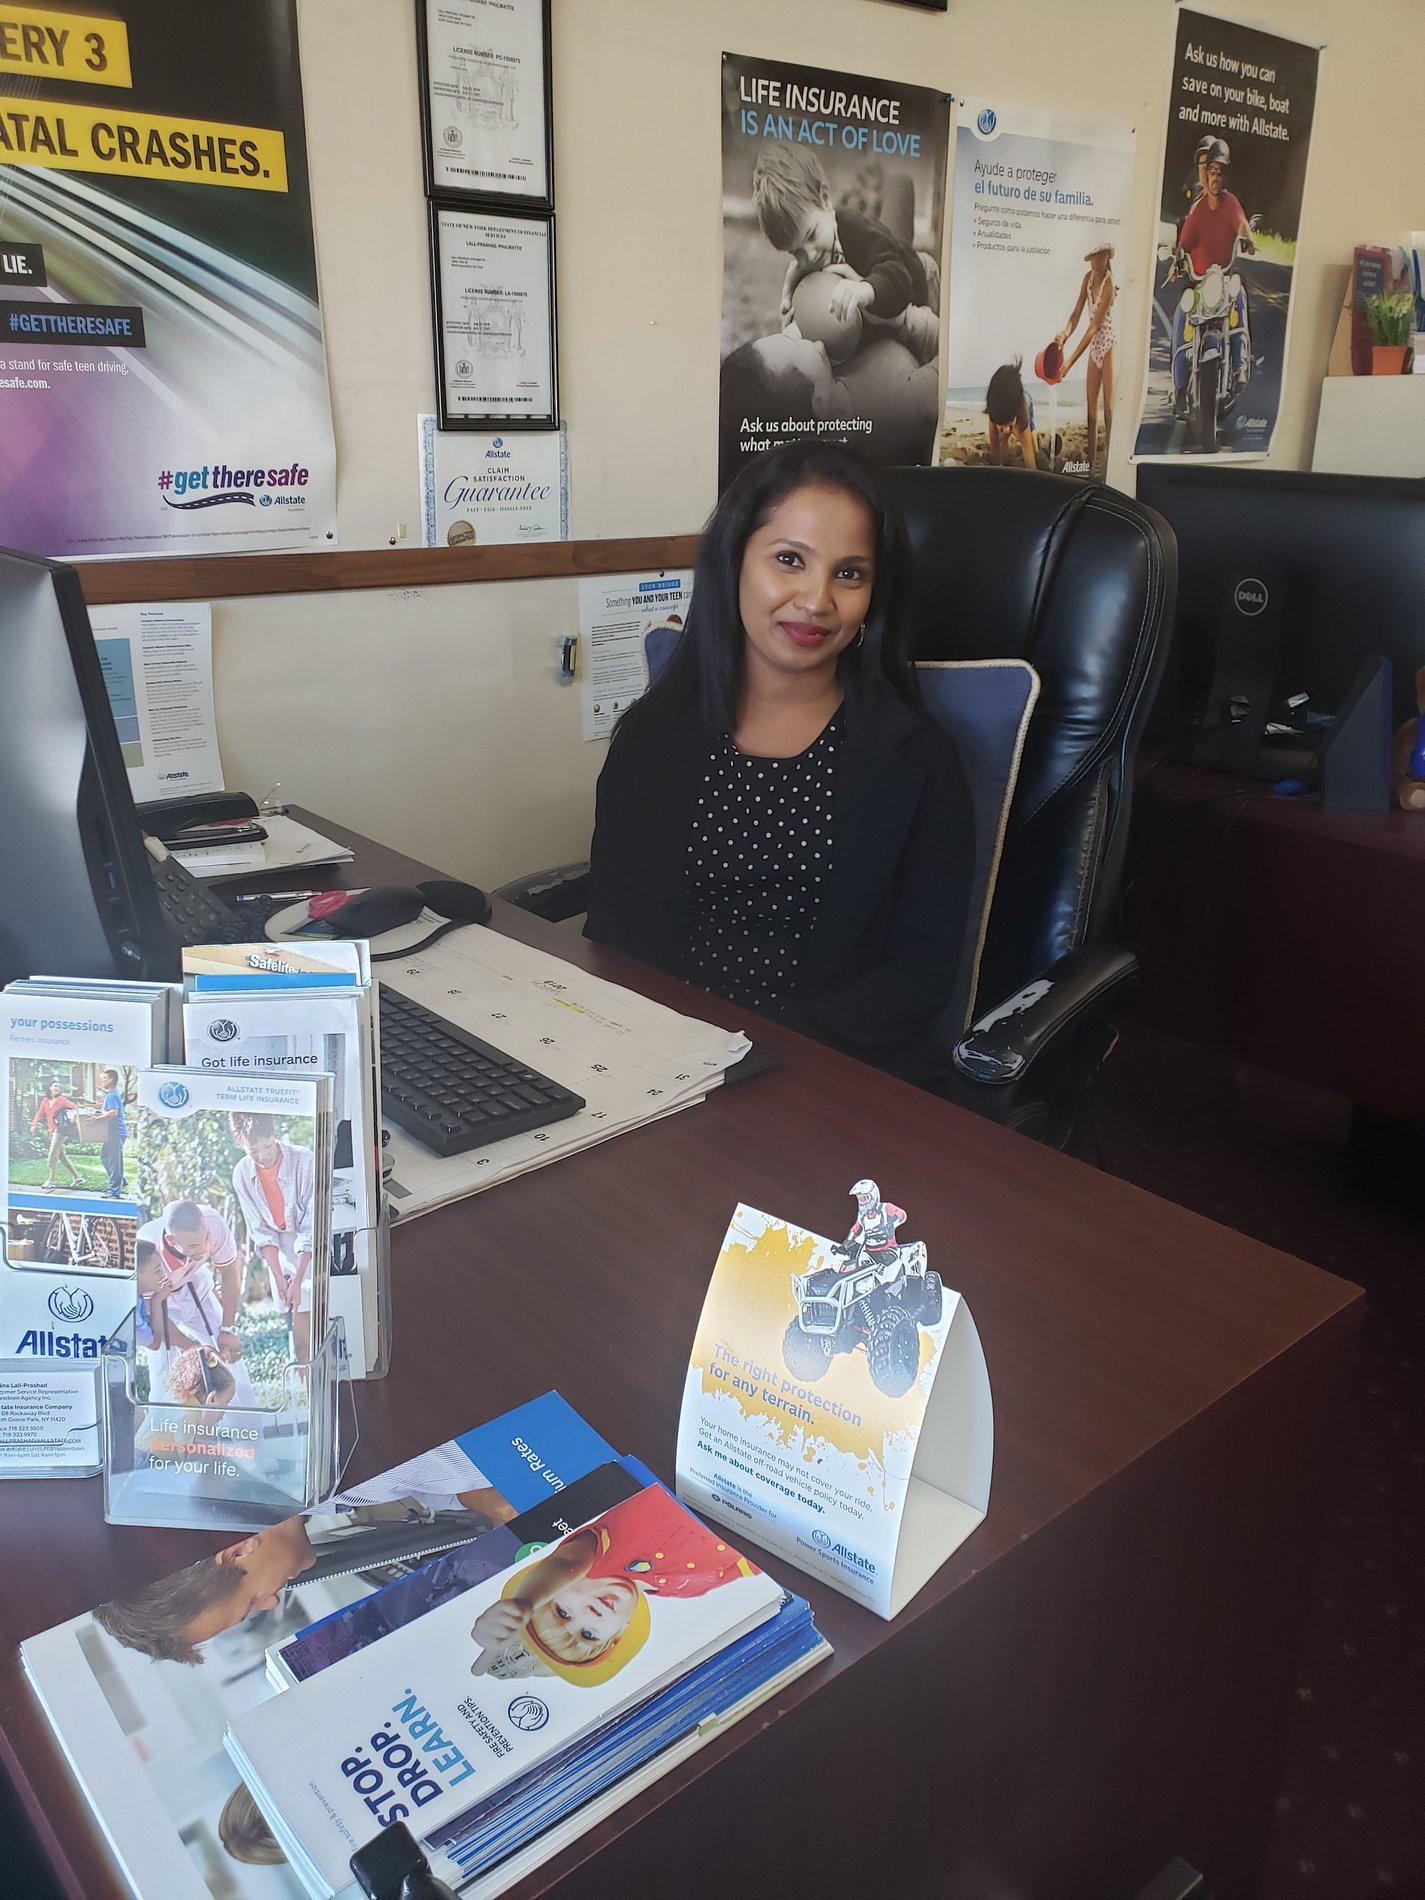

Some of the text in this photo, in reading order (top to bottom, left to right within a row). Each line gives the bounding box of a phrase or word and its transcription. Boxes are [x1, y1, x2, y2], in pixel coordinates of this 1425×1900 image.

[85, 33, 108, 72] 3
[452, 46, 474, 56] LICENSE
[1185, 43, 1275, 83] Ask us how you can
[740, 76, 900, 125] LIFE INSURANCE
[1182, 76, 1289, 114] save on your bike, boat
[1179, 103, 1290, 141] and more with Allstate.
[741, 109, 920, 158] IS AN ACT OF LOVE
[91, 122, 270, 178] CRASHES.
[975, 159, 1057, 185] Ayude a proteger
[975, 180, 1094, 206] el futuro de su familia.
[974, 202, 1000, 214] Pregunte
[1016, 208, 1040, 218] podemos
[978, 217, 1001, 227] Seguros
[1011, 221, 1021, 229] vida
[977, 230, 1011, 239] Anualidades
[976, 241, 1019, 253] Productos para
[3, 255, 32, 274] LIE.
[9, 313, 132, 336] #GETTHERESAFE
[0, 359, 129, 375] a stand for safe teen driving,
[740, 416, 873, 435] Ask us about protecting
[485, 450, 511, 458] Allstate
[740, 436, 771, 452] what
[1061, 461, 1090, 474] Allstate
[274, 496, 305, 505] Allstate
[444, 475, 551, 510] Guarantee
[606, 591, 682, 609] Something YOU AND YOUR TEEN
[1238, 590, 1264, 604] DELL
[166, 771, 189, 780] Allstate
[249, 953, 295, 974] Safelite
[10, 1017, 114, 1033] your possessions
[10, 1034, 70, 1045] Renters insurance
[201, 1054, 318, 1068] Got life insurance
[590, 1063, 608, 1073] 25
[674, 1073, 690, 1081] 31
[216, 1093, 237, 1101] TERM
[256, 1096, 299, 1104] INSURANCE
[227, 1085, 264, 1094] ALLSTATE
[646, 1088, 663, 1096] 24
[591, 1110, 607, 1118] 17
[533, 1133, 550, 1141] 10
[477, 1158, 489, 1166] 3
[709, 1362, 815, 1425] for any terrain.
[714, 1343, 862, 1427] The right protection
[150, 1418, 258, 1440] Life insurance
[148, 1440, 256, 1460] personalized
[511, 1436, 545, 1472] Rates
[149, 1456, 240, 1477] for your life.
[699, 1427, 864, 1520] Get an Allstate off-road vehicle policy today.
[700, 1416, 873, 1512] Your home insurance may not cover your ride.
[697, 1440, 825, 1514] Ask me about coverage today.
[714, 1473, 736, 1489] Allstate
[743, 1489, 752, 1498] the
[689, 1467, 777, 1518] Preferred Insurance Provider for
[796, 1536, 816, 1553] Power
[818, 1549, 840, 1566] Sports
[841, 1559, 875, 1585] Insurance
[832, 1543, 876, 1573] Allstate
[464, 1695, 478, 1713] TIPS.
[391, 1687, 477, 1787] LEARN.
[457, 1704, 505, 1758] FIRE SAFETY AND
[476, 1711, 514, 1753] PREVENTION
[370, 1721, 444, 1808] DROP.
[309, 1780, 335, 1813] prevention
[341, 1746, 410, 1828] STOP.
